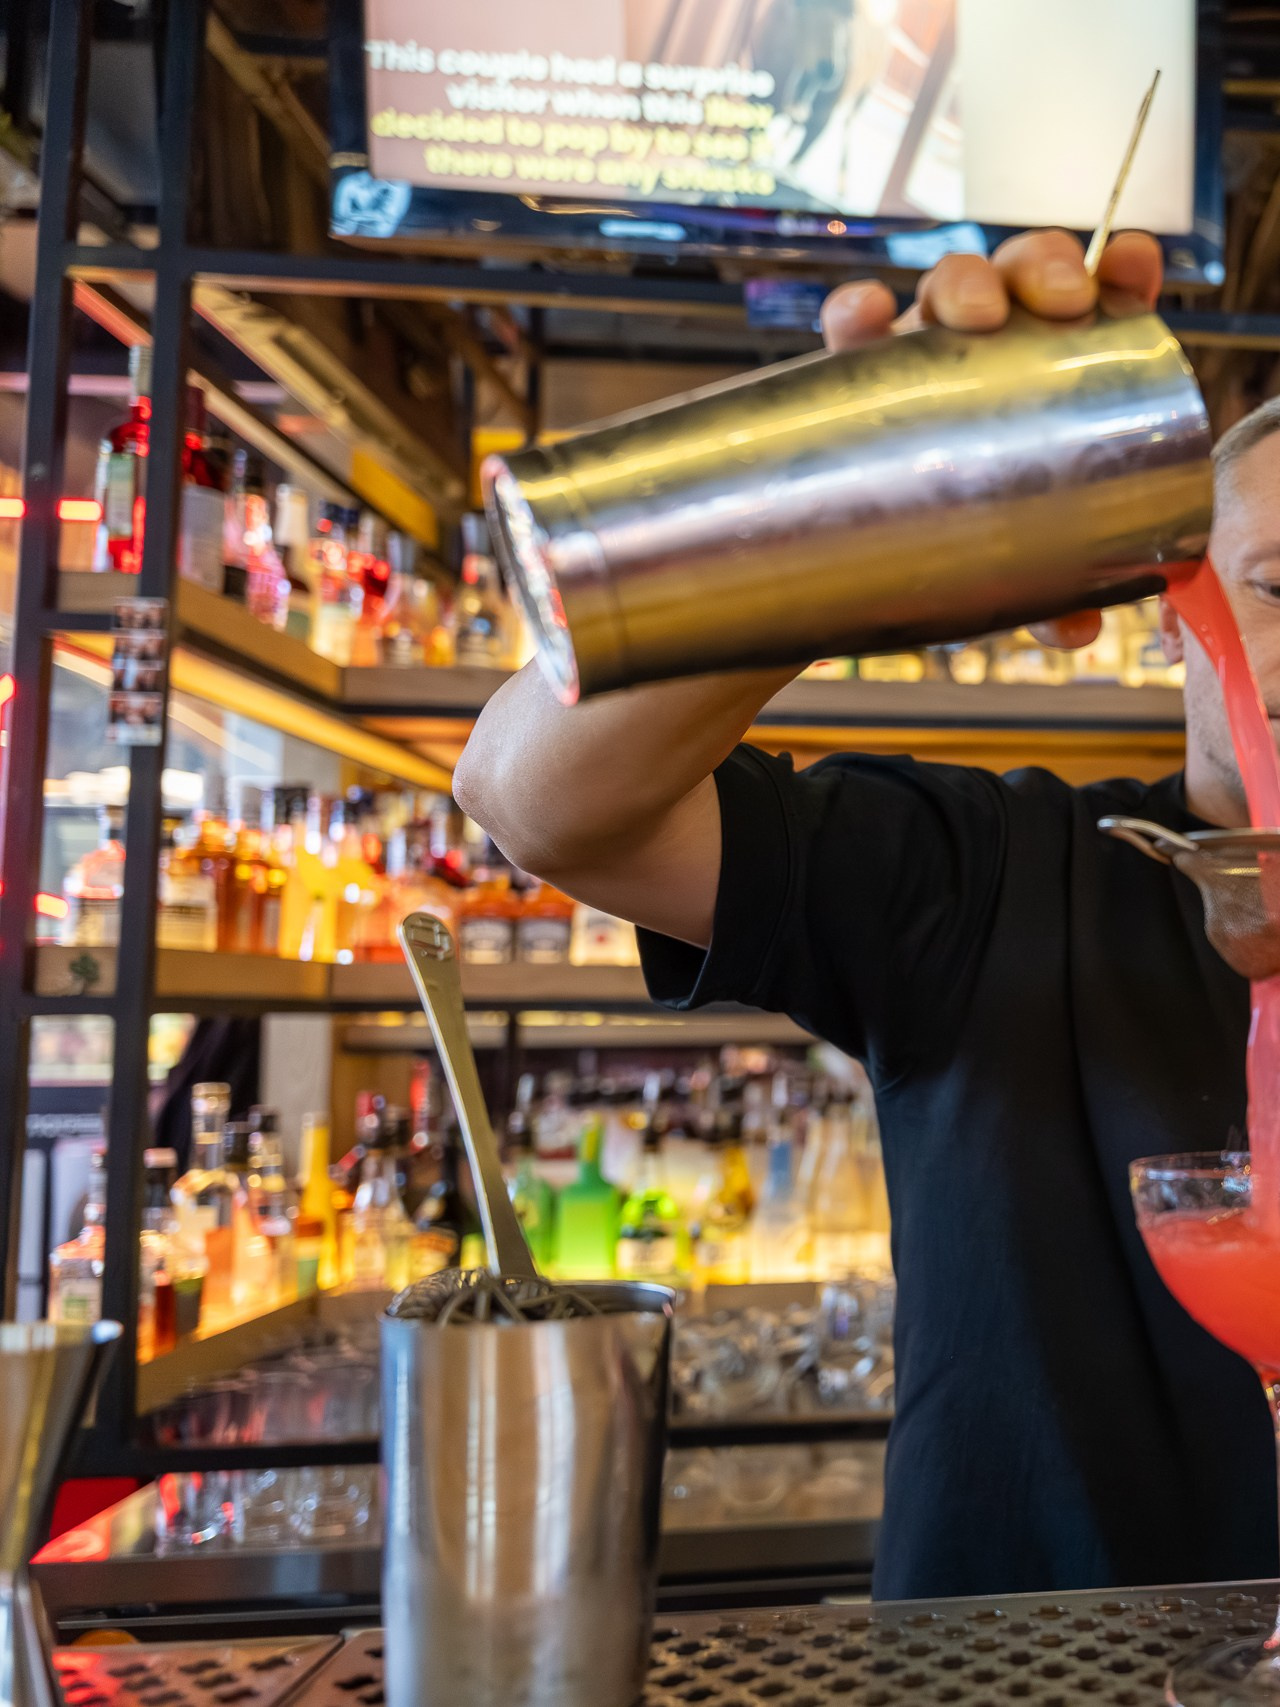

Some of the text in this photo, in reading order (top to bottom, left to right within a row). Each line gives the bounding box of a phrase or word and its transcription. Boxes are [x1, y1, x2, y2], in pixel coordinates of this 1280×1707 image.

[364, 39, 775, 99] This couple had a surprise
[445, 77, 549, 115] visitor
[550, 88, 641, 121] when
[370, 107, 504, 145] decided
[505, 115, 543, 147] to
[543, 124, 608, 157] pop
[609, 122, 653, 160] by
[654, 126, 691, 156] to
[691, 131, 749, 161] see
[424, 143, 776, 196] there were any snacks
